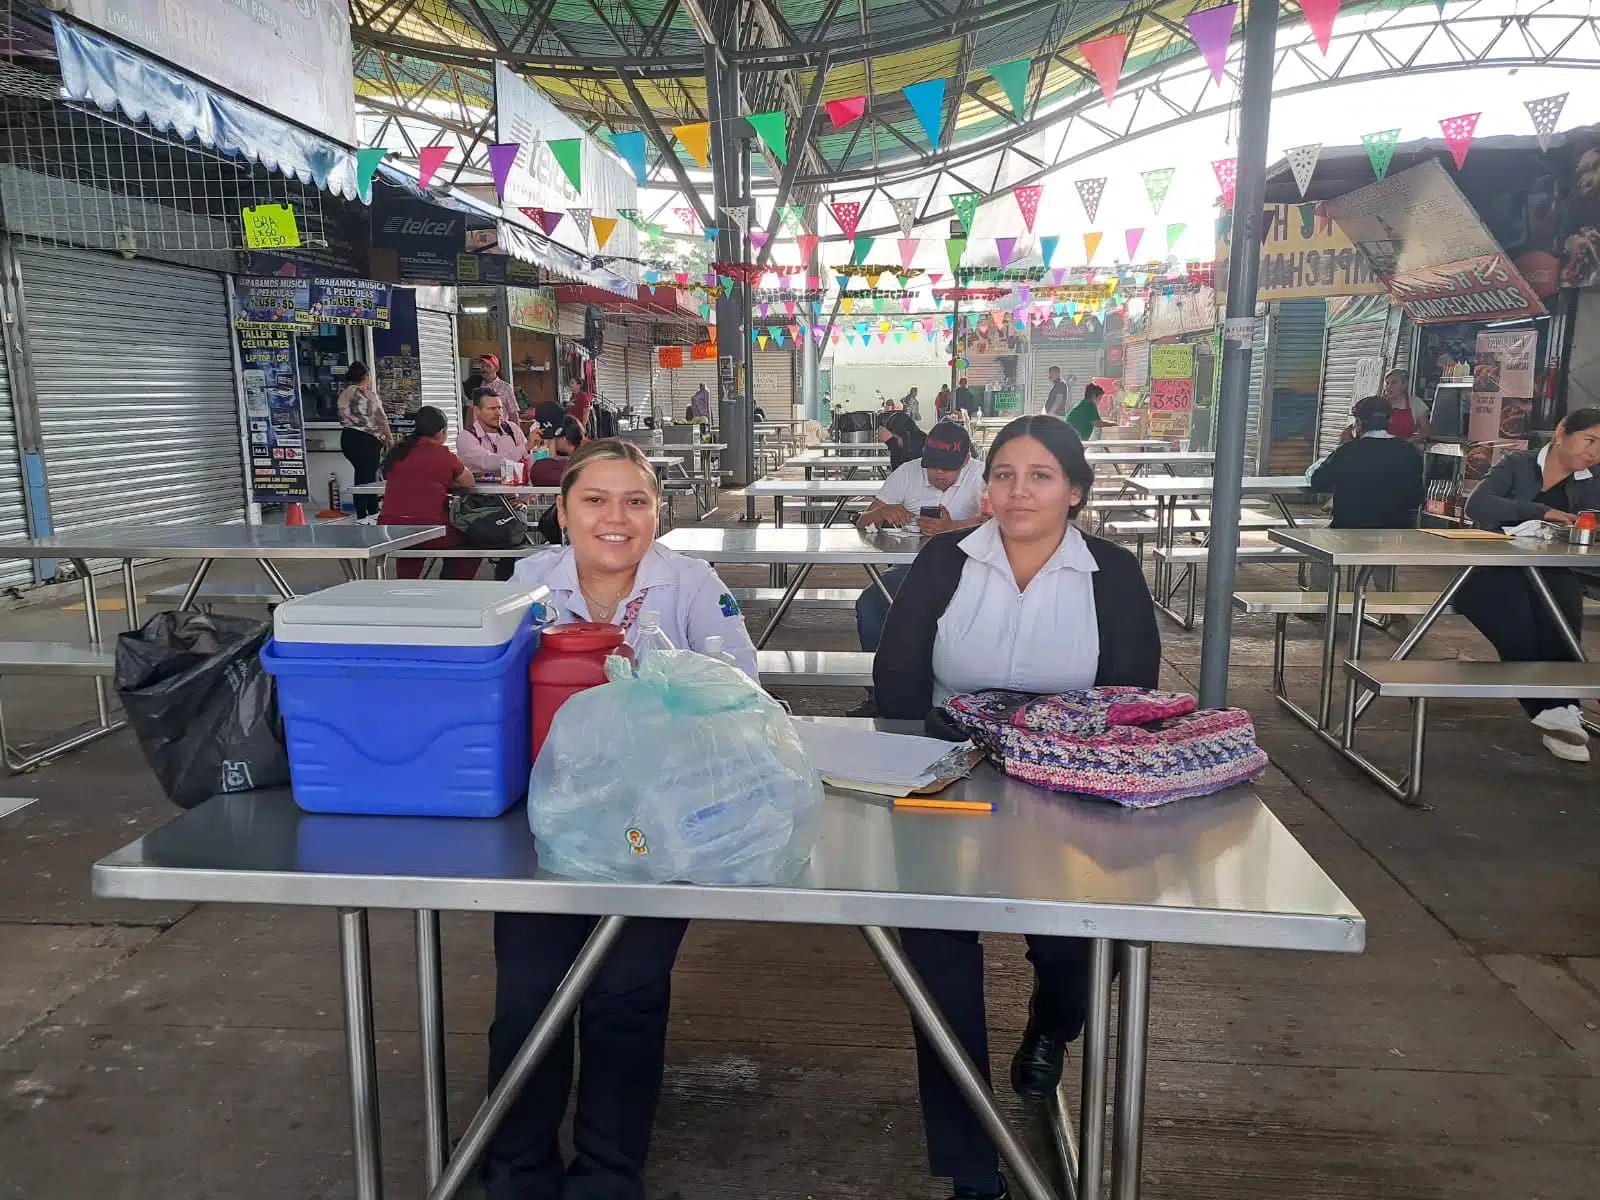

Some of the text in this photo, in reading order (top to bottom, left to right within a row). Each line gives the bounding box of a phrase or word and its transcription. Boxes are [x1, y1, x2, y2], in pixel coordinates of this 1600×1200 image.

[252, 216, 277, 229] BRA
[401, 217, 456, 237] telcel
[280, 279, 307, 289] MUSICA
[314, 278, 386, 291] GRABAMOS MUSICA
[257, 288, 295, 297] PELICULAS
[334, 288, 374, 298] PELICULAS
[259, 298, 276, 307] USB
[282, 299, 294, 309] SD
[338, 297, 355, 307] USB
[363, 298, 373, 310] SD
[1407, 286, 1529, 317] CAMPECHANAS
[313, 315, 387, 329] TALLER DE CELULARES
[241, 330, 288, 339] TALLER DE
[241, 339, 289, 349] CELULARES
